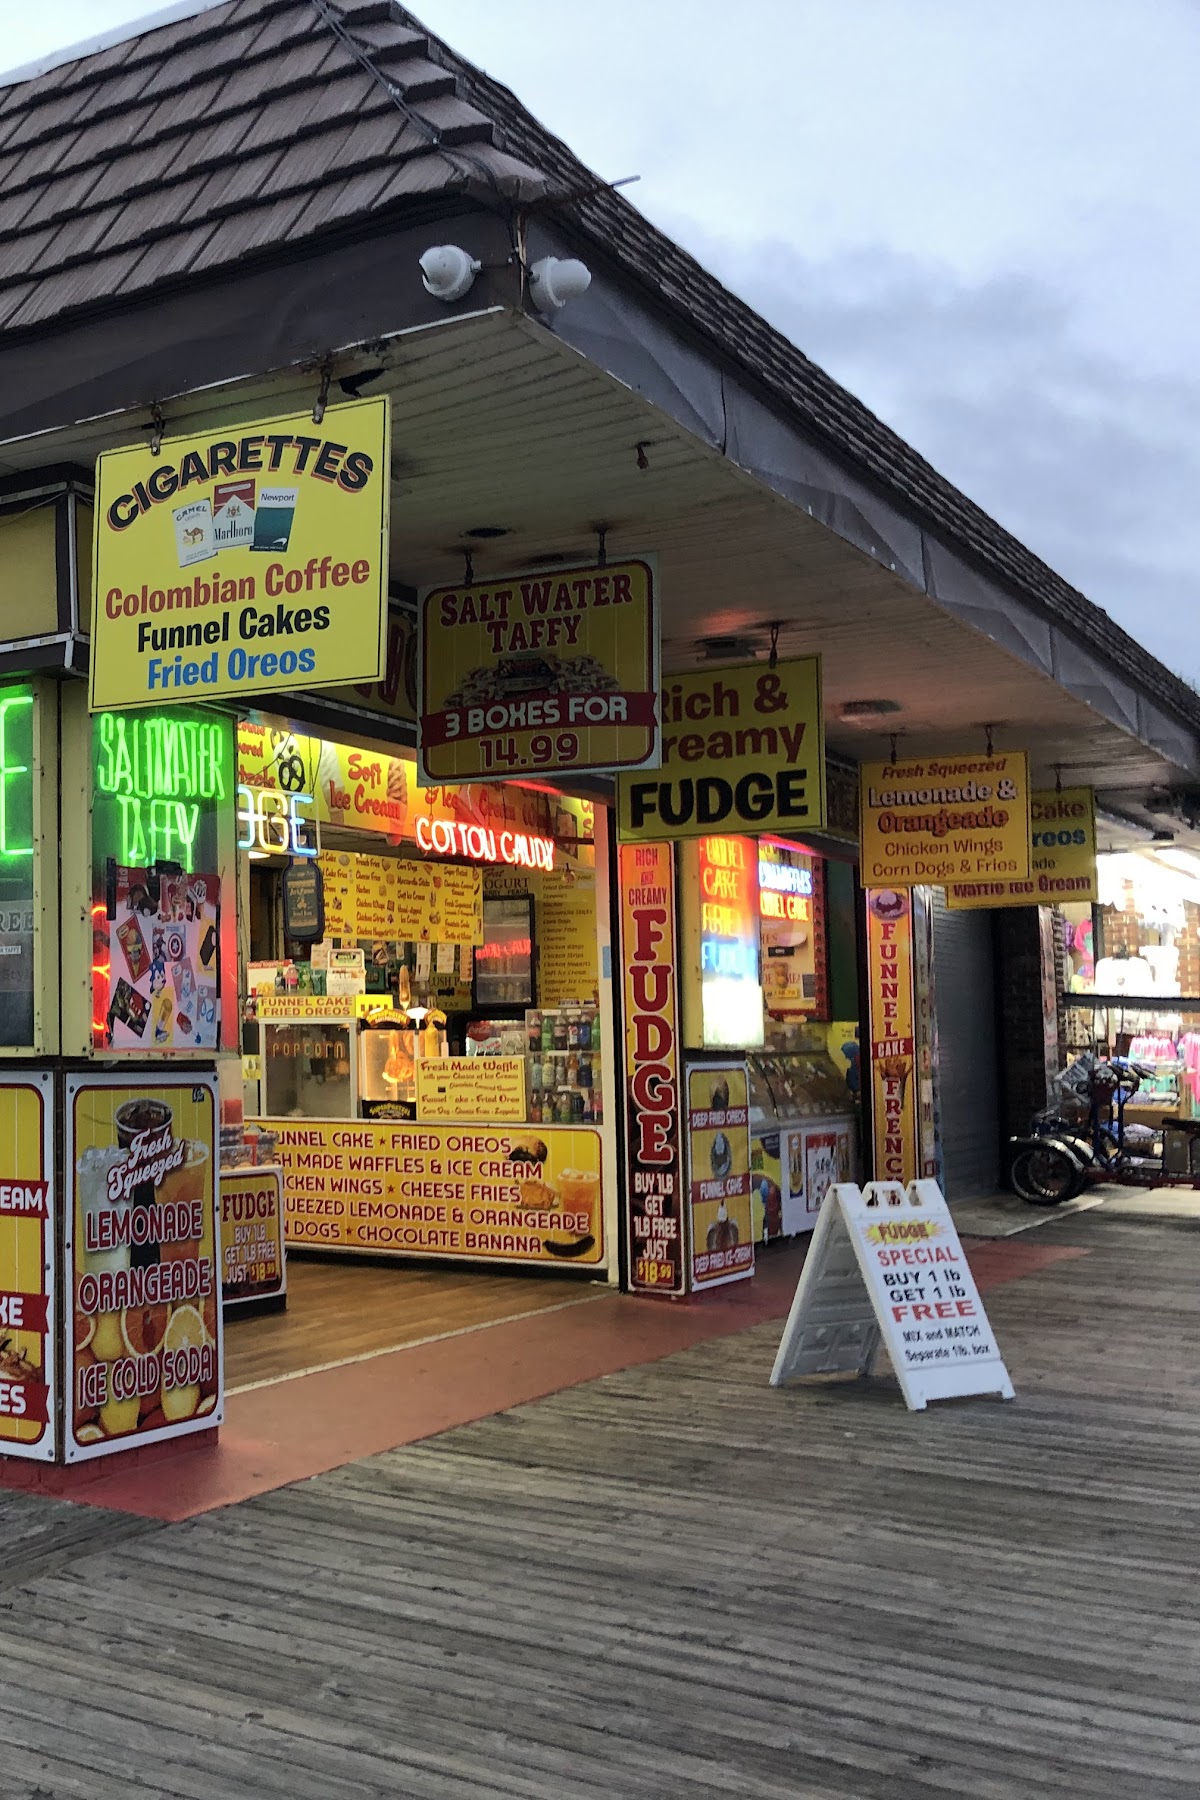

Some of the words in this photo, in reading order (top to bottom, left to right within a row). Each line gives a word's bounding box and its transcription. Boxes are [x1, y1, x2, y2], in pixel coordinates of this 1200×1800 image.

[107, 435, 374, 531] CIGARETTES
[260, 492, 295, 503] Newport
[176, 505, 207, 522] CAMEL
[213, 520, 253, 541] Marlboro
[105, 573, 255, 619] Colombian
[265, 556, 370, 596] Coffee
[440, 591, 513, 627] SALT
[520, 574, 632, 616] WATER
[138, 612, 229, 652] Funnel
[239, 604, 330, 640] Cakes
[487, 615, 582, 653] TAFFY
[148, 652, 219, 690] Fried
[228, 647, 316, 681] Oreos
[753, 673, 789, 714] &
[445, 713, 460, 737] 3
[468, 699, 560, 733] BOXES
[568, 695, 628, 723] FOR
[479, 733, 579, 768] 14.99
[881, 764, 924, 780] Fresh
[928, 758, 1008, 779] Squeezed
[630, 768, 809, 829] FUDGE
[868, 781, 993, 808] Lemonade
[997, 777, 1017, 800] &
[117, 795, 199, 874] TAFFY
[878, 806, 1010, 838] Orangeade
[415, 815, 497, 862] COTTON
[500, 831, 556, 872] CANDY
[885, 840, 949, 857] Chicken
[953, 838, 1004, 856] Wings
[635, 847, 659, 867] RICH
[873, 863, 911, 878] Corn
[914, 860, 955, 879] Dogs
[960, 860, 972, 873] &
[976, 857, 1017, 872] Fries
[628, 887, 667, 906] CREAMY
[261, 997, 313, 1006] FUNNEL
[316, 996, 353, 1006] CAKE
[263, 1007, 302, 1017] FRIED
[305, 1006, 351, 1016] OREOS
[878, 1039, 905, 1056] CAKE
[420, 1061, 449, 1071] Fresh
[450, 1061, 481, 1071] Made
[483, 1061, 519, 1072] Waffle
[129, 1126, 172, 1166] Fresh
[333, 1132, 374, 1148] CAKE
[391, 1135, 440, 1151] FRIED
[446, 1137, 512, 1154] OREOS
[107, 1140, 185, 1200] Squeezed
[297, 1154, 343, 1170] MADE
[349, 1156, 424, 1173] WAFFLES
[430, 1159, 442, 1174] &
[448, 1160, 471, 1176] ICE
[479, 1161, 542, 1179] CREAM
[330, 1177, 383, 1195] WINGS
[401, 1181, 465, 1200] CHEESE
[471, 1185, 521, 1203] FRIES
[700, 1181, 725, 1199] FUNNEL
[726, 1179, 743, 1195] CAKE
[222, 1190, 276, 1223] FUDGE
[350, 1202, 446, 1222] LEMONADE
[452, 1208, 464, 1223] &
[470, 1208, 590, 1232] ORANGEADE
[86, 1201, 204, 1253] LEMONADE
[294, 1222, 341, 1238] DOGS
[357, 1226, 460, 1247] CHOCOLATE
[465, 1233, 542, 1253] BANANA
[878, 1221, 929, 1240] FUDGE
[877, 1246, 959, 1268] SPECIAL
[78, 1257, 212, 1316] ORANGEADE
[883, 1270, 920, 1286] BUY
[928, 1270, 938, 1282] 1
[944, 1268, 961, 1282] lb
[889, 1287, 925, 1302] GET
[933, 1286, 942, 1299] 1
[949, 1285, 966, 1298] lb
[891, 1300, 977, 1323] FREE
[903, 1330, 921, 1342] MIX
[925, 1329, 943, 1340] and
[945, 1325, 981, 1340] MATCH
[905, 1347, 949, 1363] Separate
[972, 1343, 991, 1356] box
[78, 1361, 108, 1409] ICE
[111, 1354, 161, 1401] COLD
[163, 1343, 213, 1391] SODA
